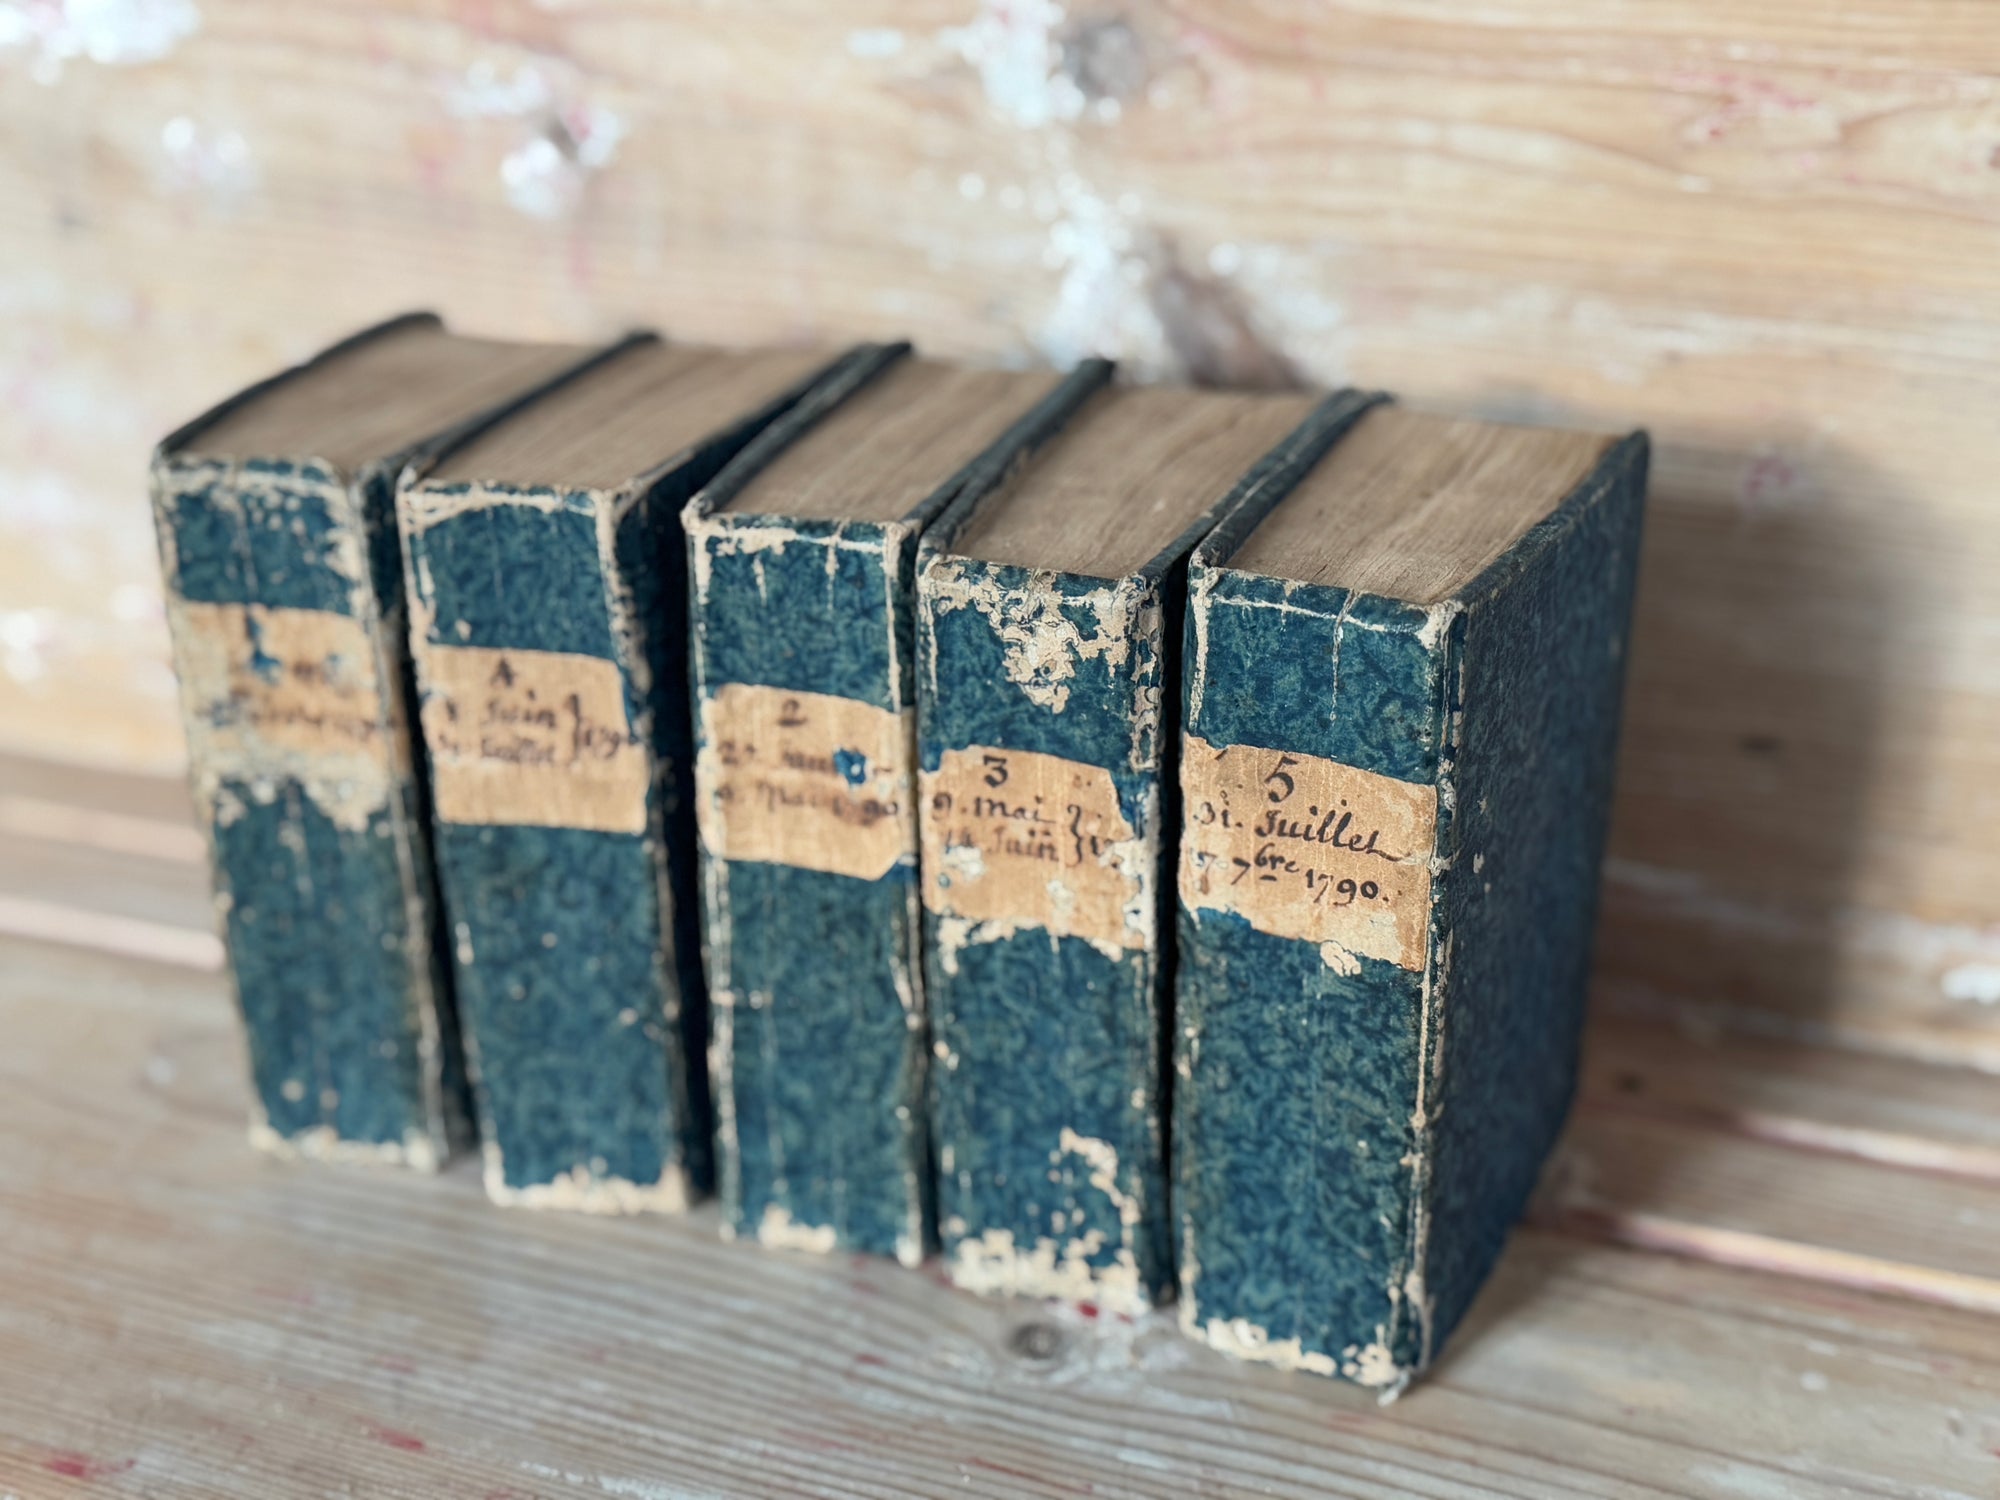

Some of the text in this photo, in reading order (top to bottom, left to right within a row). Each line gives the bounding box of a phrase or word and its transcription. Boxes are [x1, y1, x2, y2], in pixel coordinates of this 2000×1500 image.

[777, 698, 807, 727] 2
[982, 754, 1009, 789] 3
[1264, 755, 1298, 803] 5
[985, 825, 1060, 863] Juin
[1254, 798, 1412, 862] Juillet
[1304, 868, 1390, 907] 1790.
